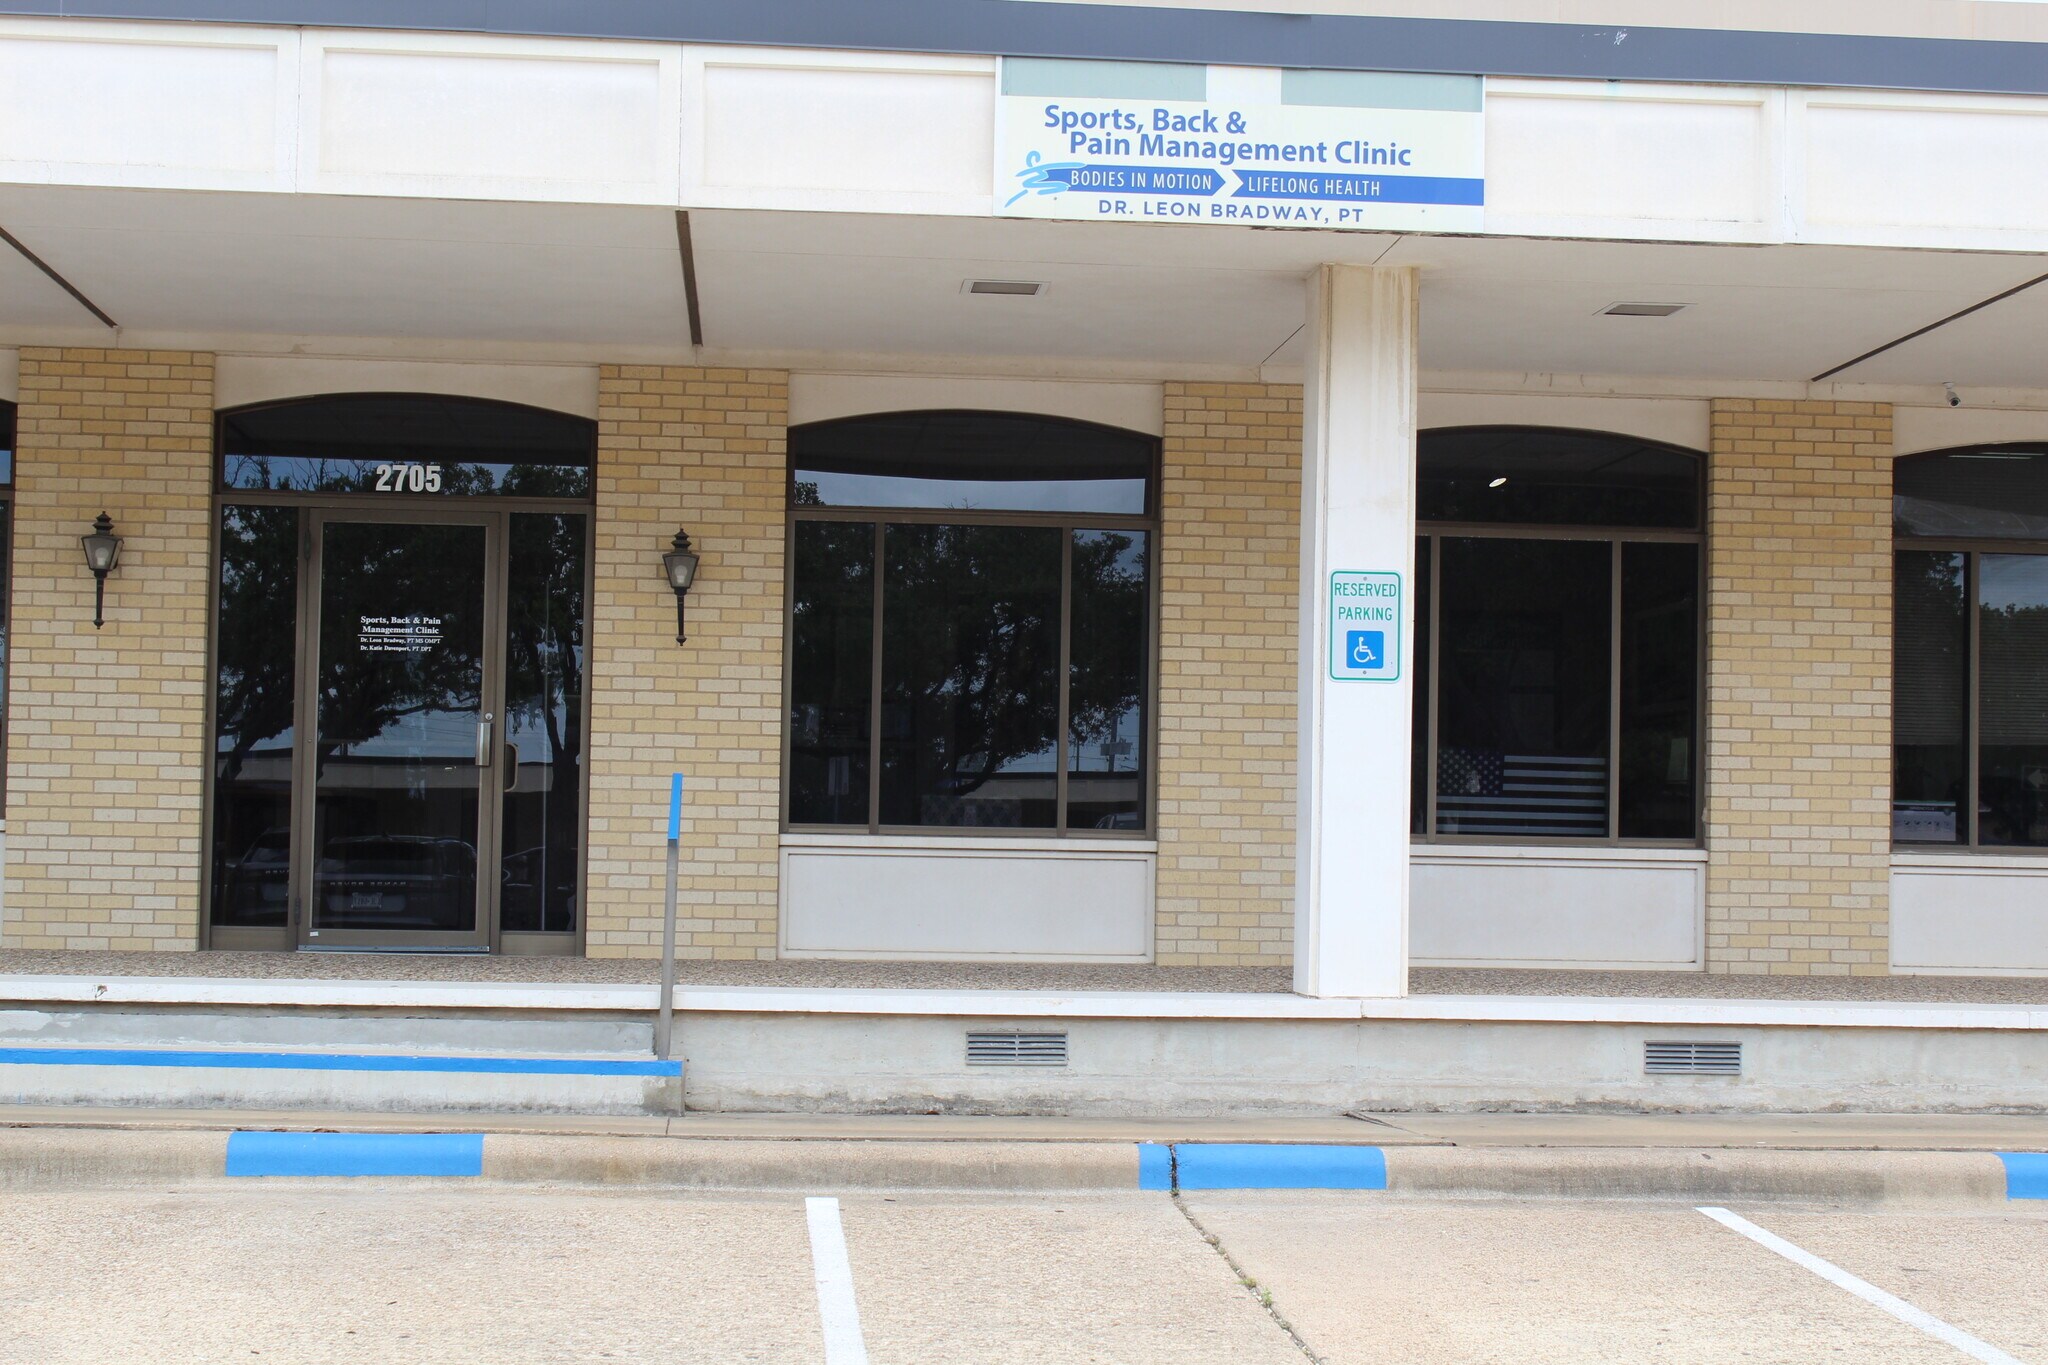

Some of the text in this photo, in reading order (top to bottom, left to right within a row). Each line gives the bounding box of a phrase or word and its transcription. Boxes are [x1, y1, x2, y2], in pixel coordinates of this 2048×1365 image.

[1044, 104, 1247, 134] Sports, Back &
[1070, 131, 1411, 166] Pain Management Clinic
[1070, 170, 1380, 196] BODIES IN MOTION LIFELONG HEALTH
[1099, 199, 1363, 224] DR. LEON BRADWAY, PT
[375, 464, 441, 493] 2705
[1334, 582, 1397, 597] RESERVED
[360, 616, 389, 625] Sports,
[391, 616, 411, 624] Back
[422, 617, 441, 625] Pain
[1338, 606, 1393, 621] PARKING
[362, 626, 439, 634] Management Clinic
